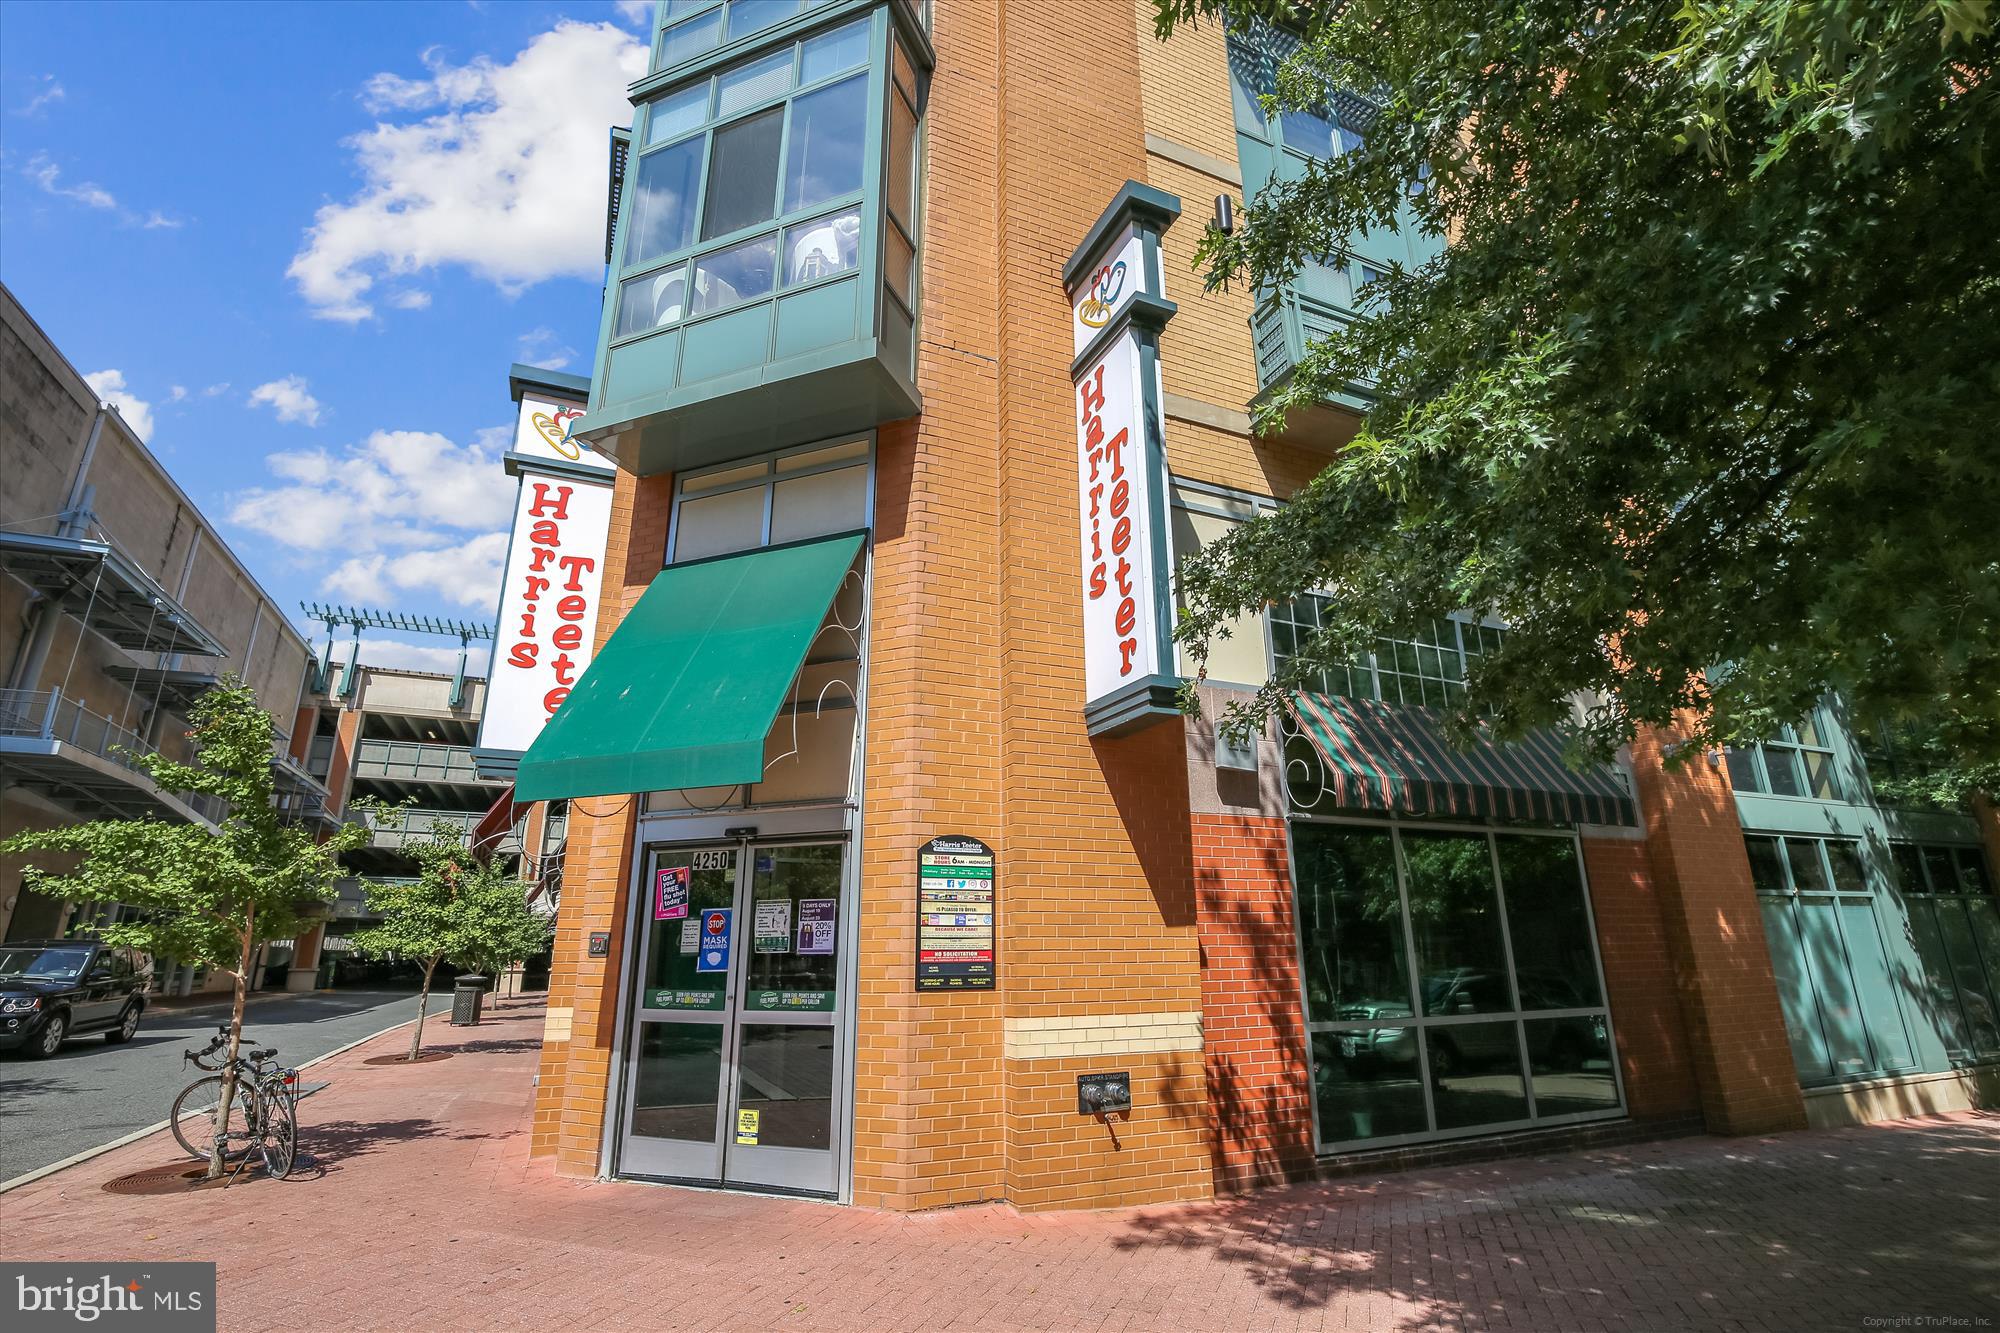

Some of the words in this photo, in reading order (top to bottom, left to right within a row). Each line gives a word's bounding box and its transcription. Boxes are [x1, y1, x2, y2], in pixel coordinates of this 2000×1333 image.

[1081, 364, 1106, 600] Harris
[1106, 427, 1137, 678] Teeter
[508, 483, 573, 669] Harris
[543, 556, 595, 723] Teete
[961, 841, 982, 849] Teeter
[694, 852, 728, 869] 4250
[663, 879, 676, 888] your
[664, 885, 679, 894] FREE
[673, 889, 685, 898] shot
[708, 920, 723, 928] STOP
[704, 936, 728, 944] MASK
